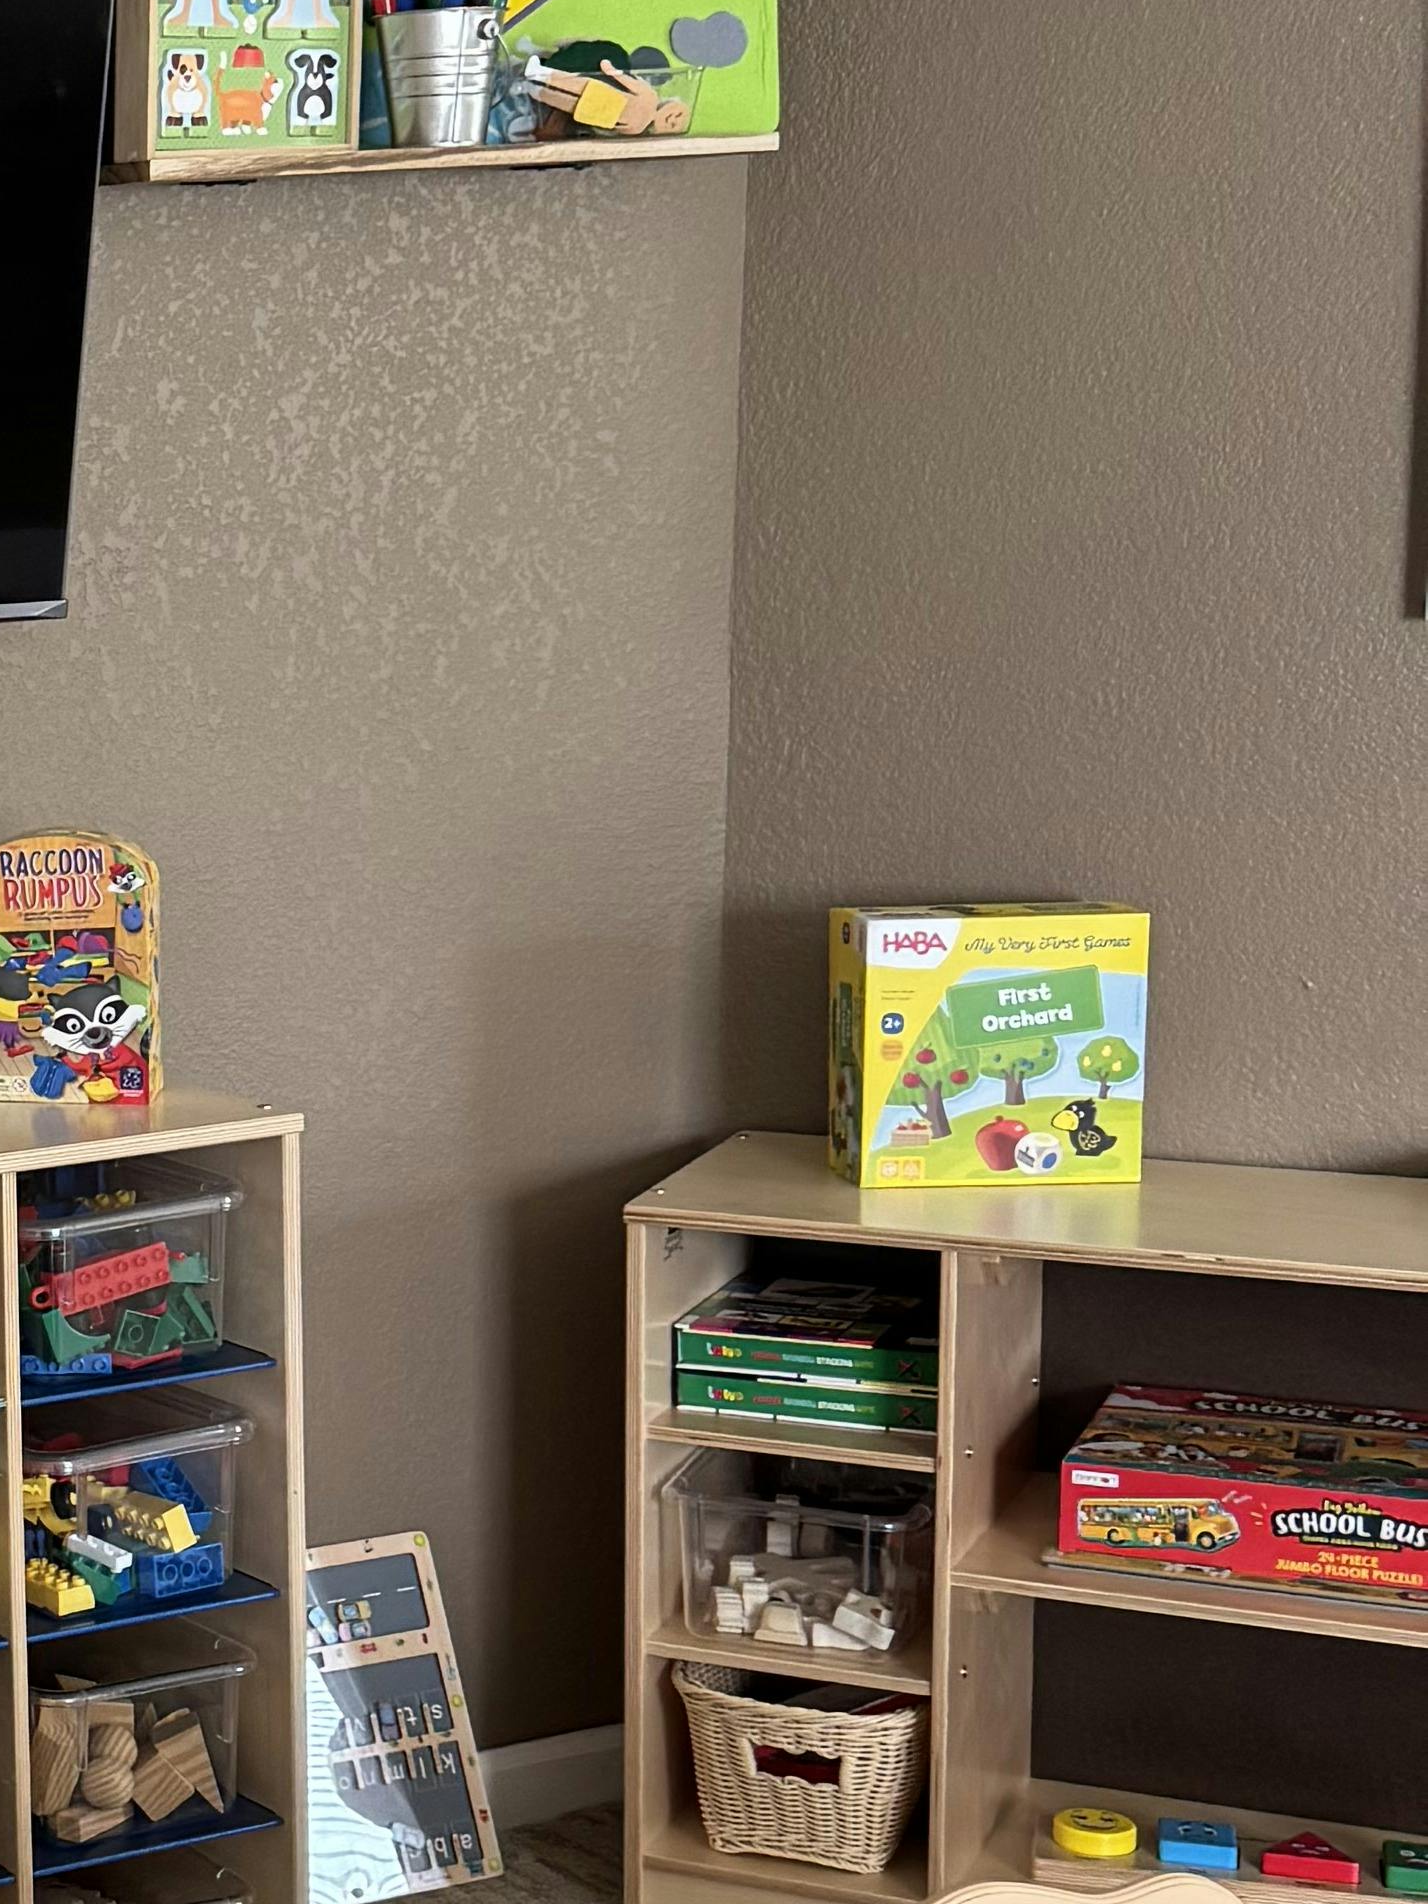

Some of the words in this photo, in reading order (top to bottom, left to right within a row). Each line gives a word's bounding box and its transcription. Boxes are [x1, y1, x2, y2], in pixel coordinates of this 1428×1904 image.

[0, 847, 104, 878] RACCOON
[4, 876, 102, 911] RUMPUS
[883, 931, 948, 955] HABA
[964, 937, 995, 954] My
[998, 936, 1036, 954] Very
[1039, 936, 1080, 950] First
[1084, 935, 1132, 952] Games
[998, 982, 1053, 1007] First
[884, 1017, 901, 1029] 2+
[982, 1003, 1074, 1033] Orchard
[1194, 1400, 1336, 1421] SCHOOL
[1351, 1413, 1419, 1431] BUS
[1275, 1511, 1372, 1538] SCHOOL
[1379, 1519, 1428, 1548] BUS
[1275, 1558, 1323, 1574] JUMBO
[1324, 1564, 1370, 1581] FLOOR
